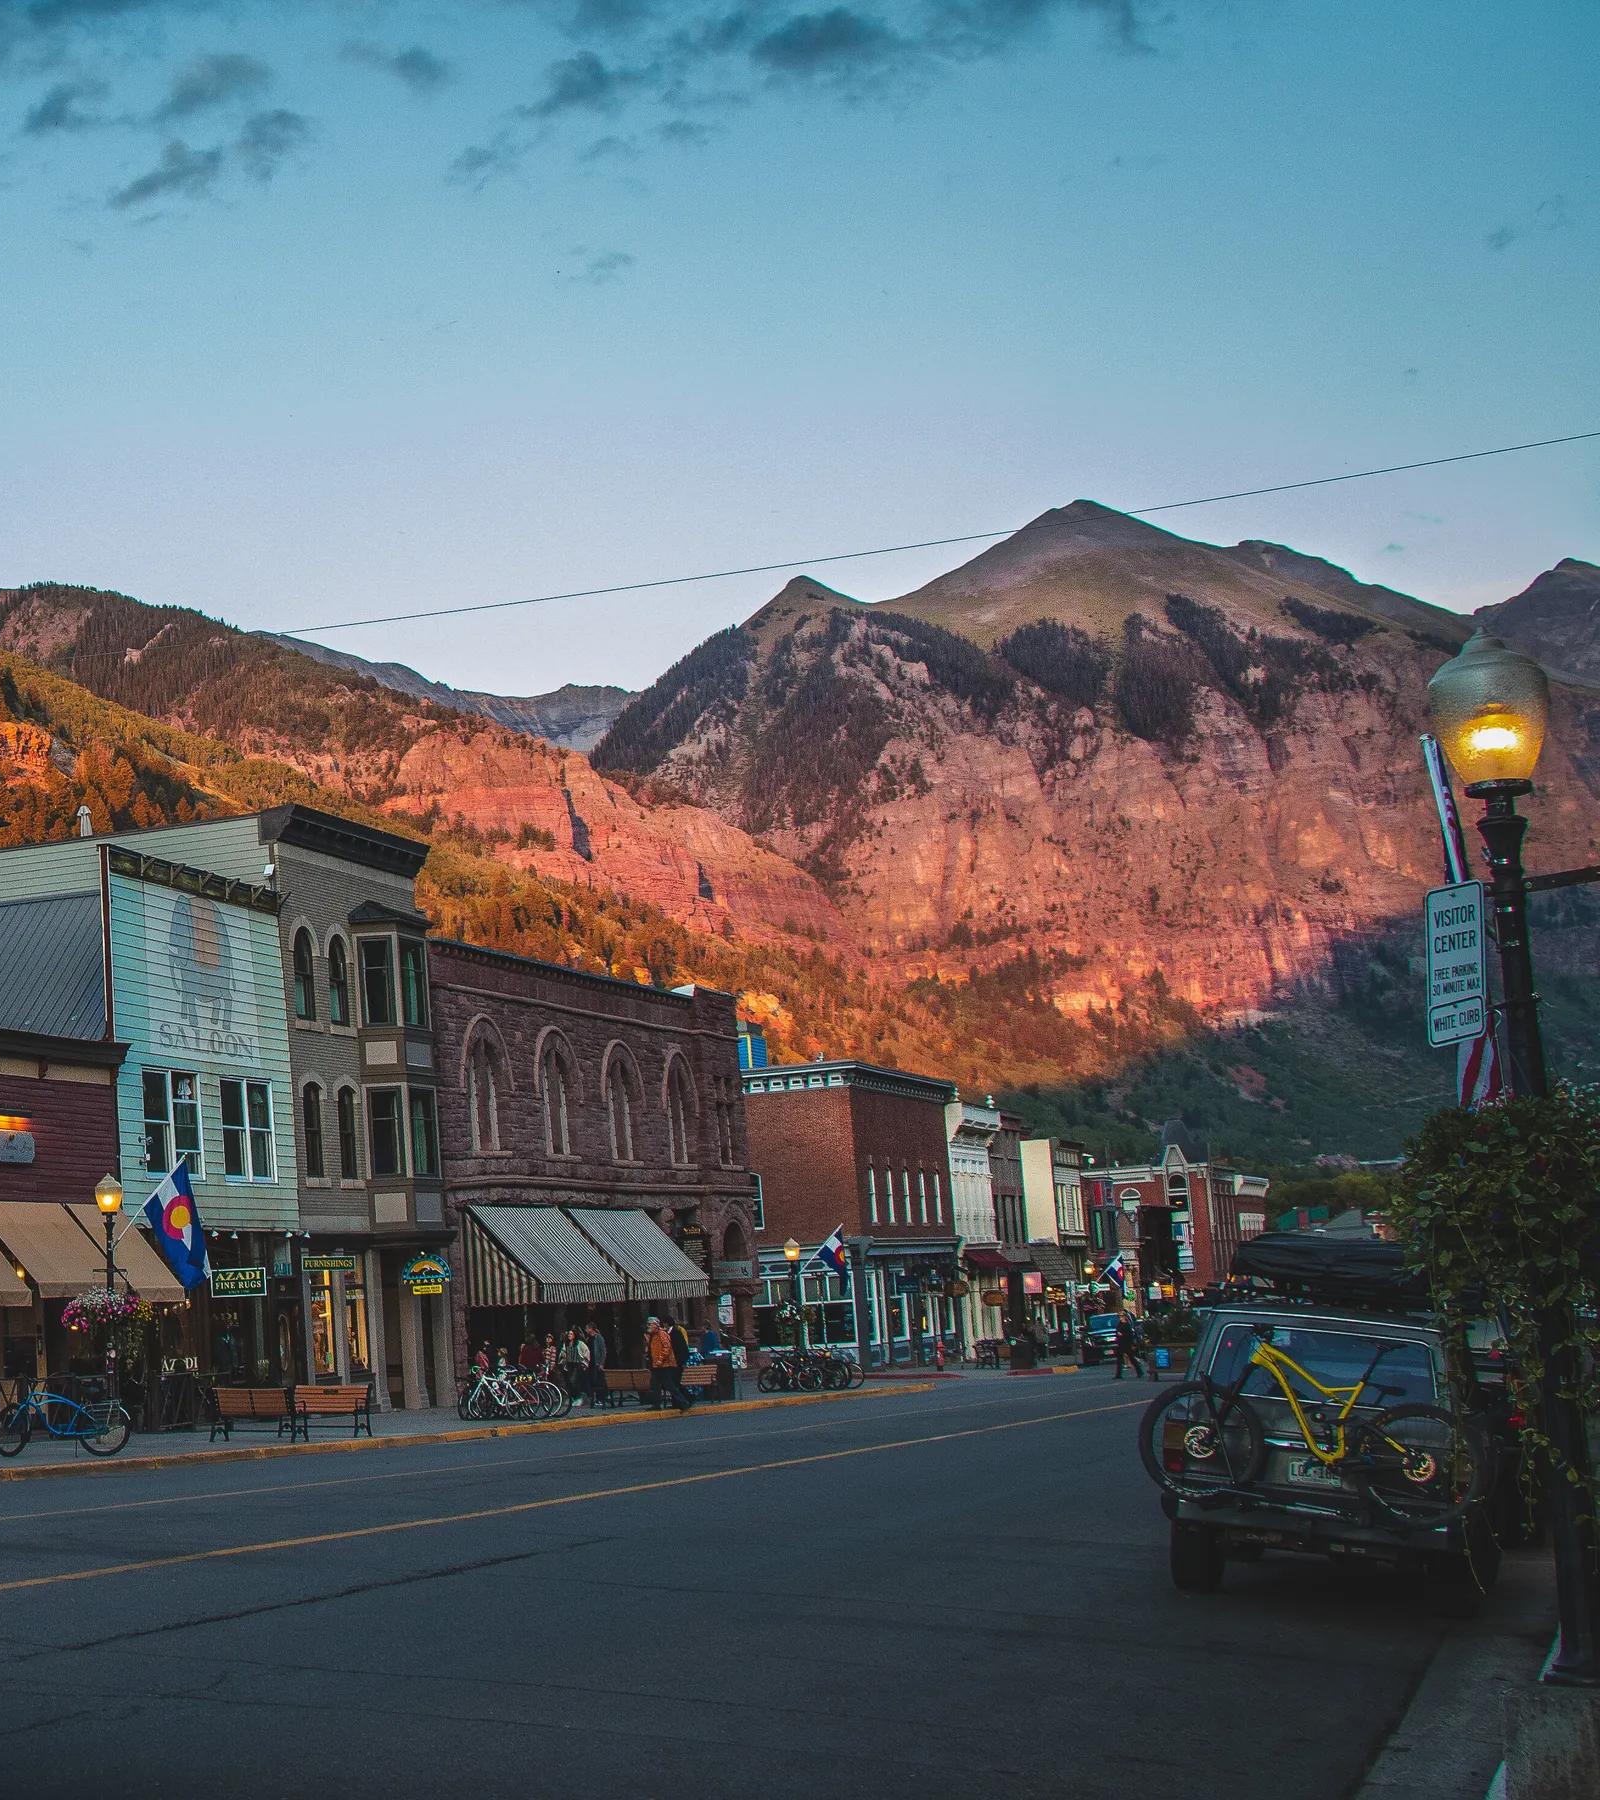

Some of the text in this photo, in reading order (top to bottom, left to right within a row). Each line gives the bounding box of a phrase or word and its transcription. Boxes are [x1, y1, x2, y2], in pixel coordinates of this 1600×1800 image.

[1434, 904, 1475, 929] VISITOR
[1434, 930, 1476, 954] CENTER
[1434, 961, 1478, 982] FREE PARKING
[1432, 976, 1481, 997] 30 MINUTE MAX
[1433, 1007, 1481, 1033] WHITE CURB
[158, 1022, 255, 1063] SALOON
[304, 1259, 354, 1268] FURNISHINGS
[214, 1270, 262, 1281] AZADI
[215, 1280, 262, 1290] FINE RUGS
[403, 1277, 450, 1285] PARAGON
[161, 1356, 199, 1373] AZDI
